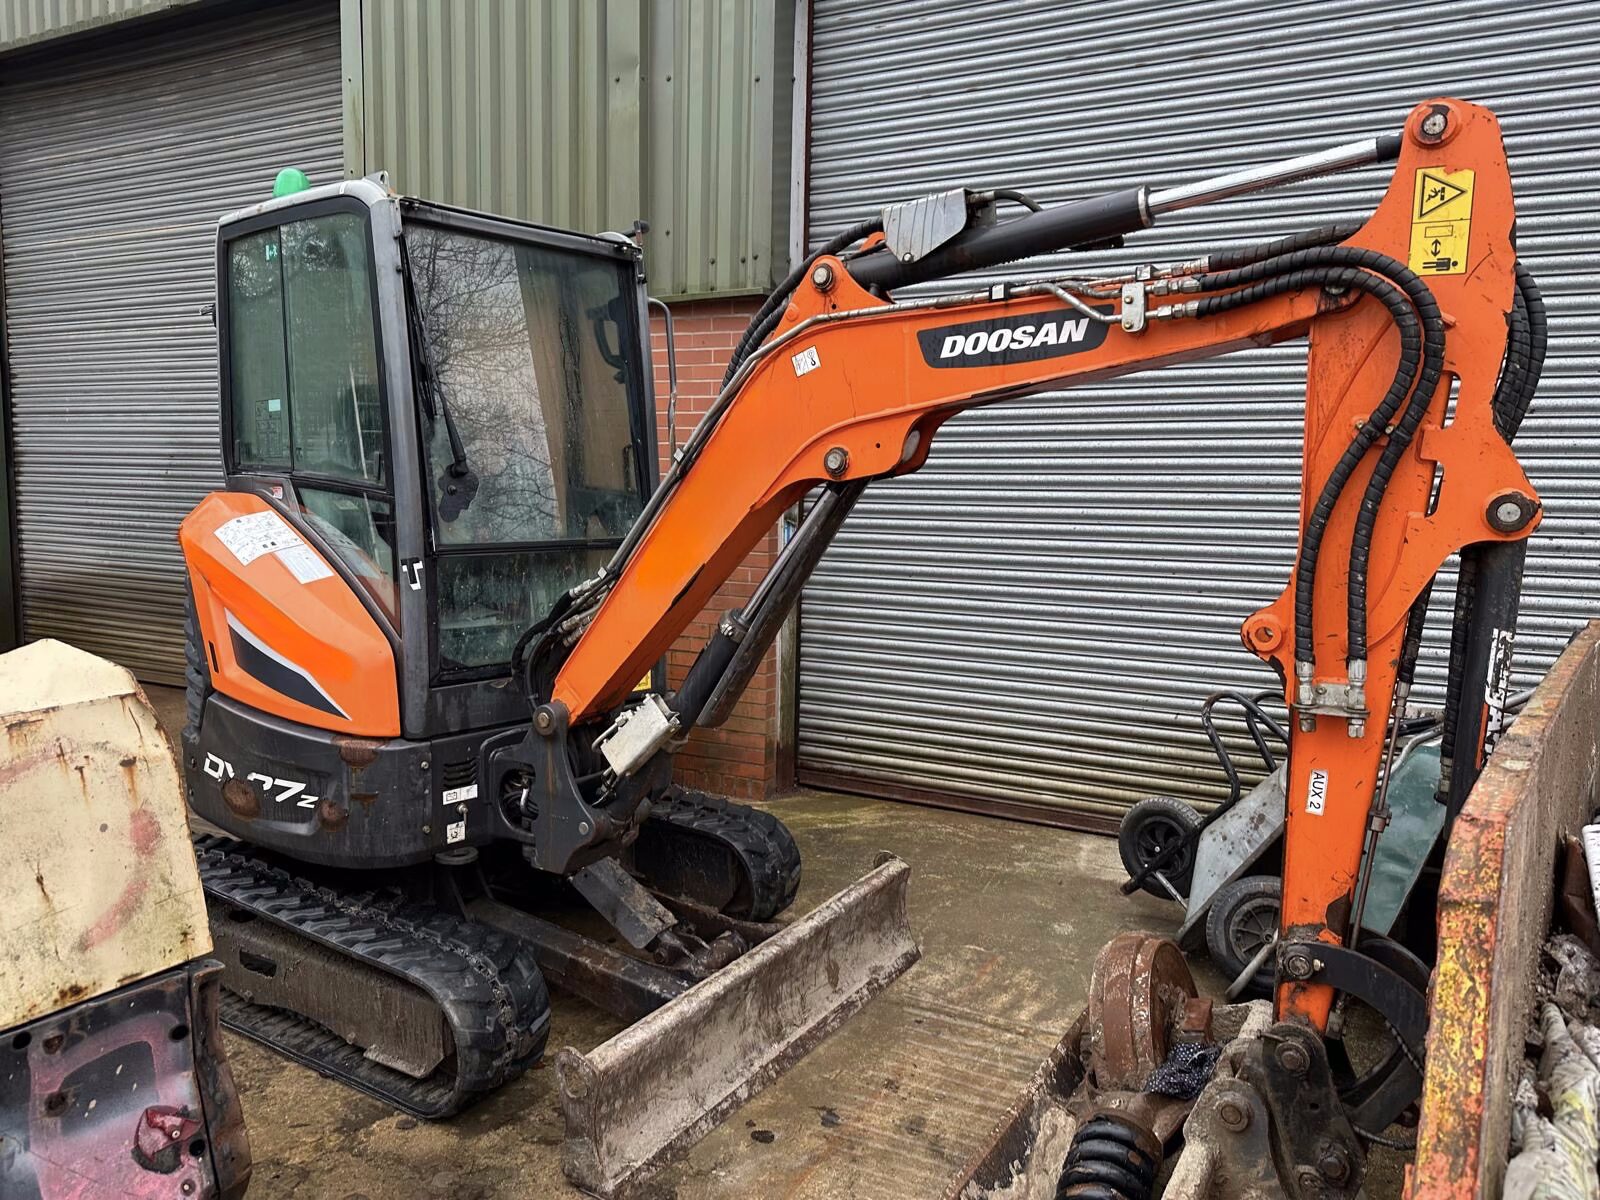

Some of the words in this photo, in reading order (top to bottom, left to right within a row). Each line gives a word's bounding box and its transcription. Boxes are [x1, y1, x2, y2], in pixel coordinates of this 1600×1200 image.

[940, 318, 1089, 358] DOOSAN
[1311, 771, 1325, 799] AUX
[1309, 801, 1321, 810] 2
